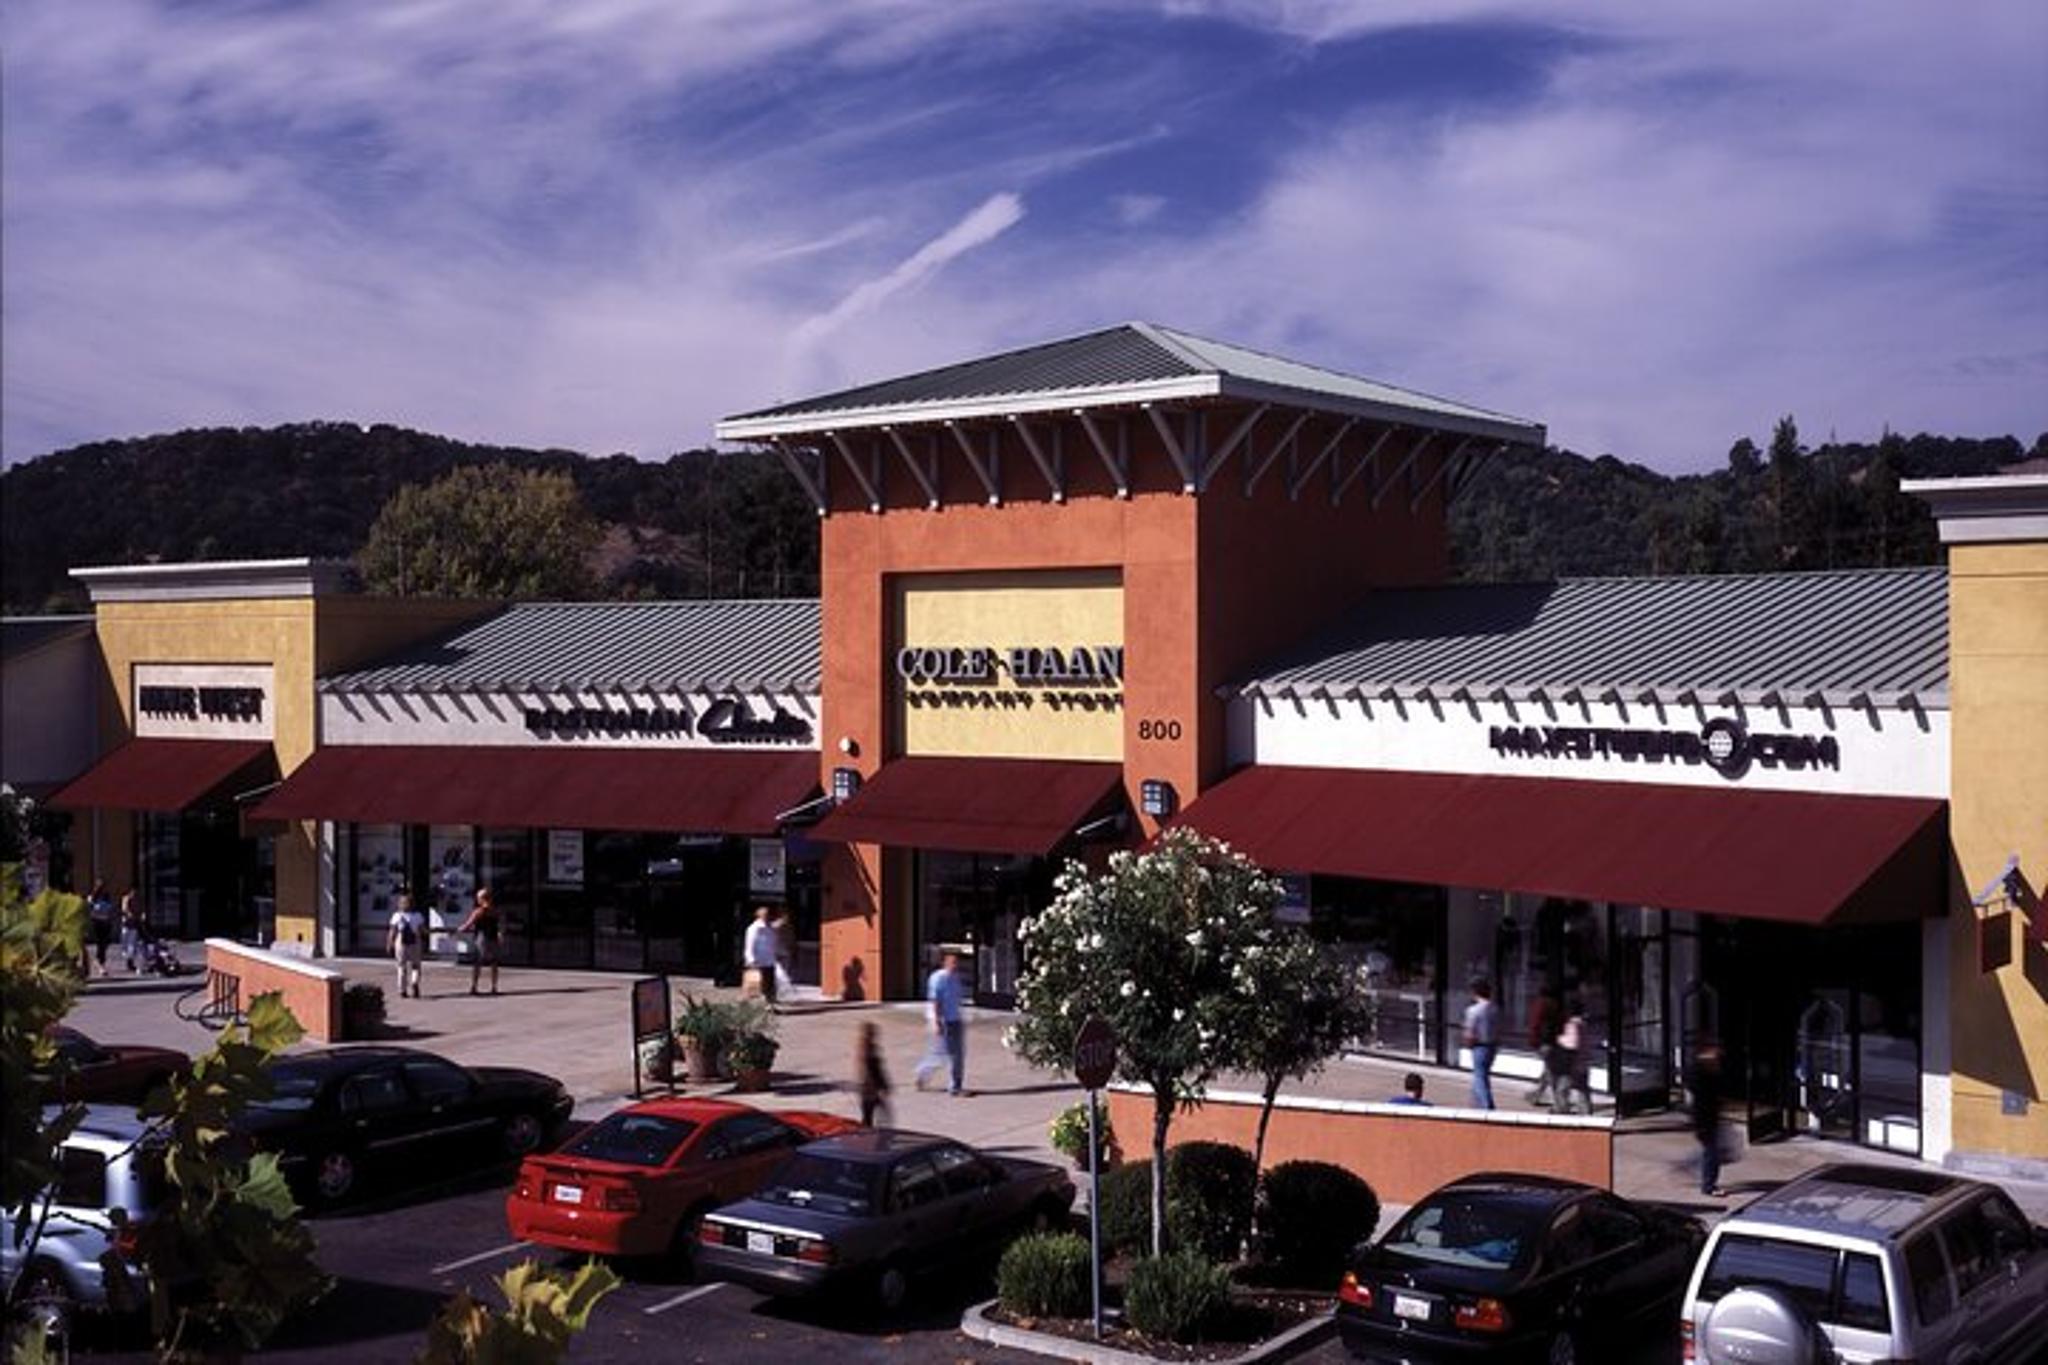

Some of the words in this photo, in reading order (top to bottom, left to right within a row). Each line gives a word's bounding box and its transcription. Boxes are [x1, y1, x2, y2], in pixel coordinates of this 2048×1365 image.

[898, 647, 988, 680] COLE
[1008, 646, 1122, 681] HAAN
[1139, 719, 1181, 740] 800
